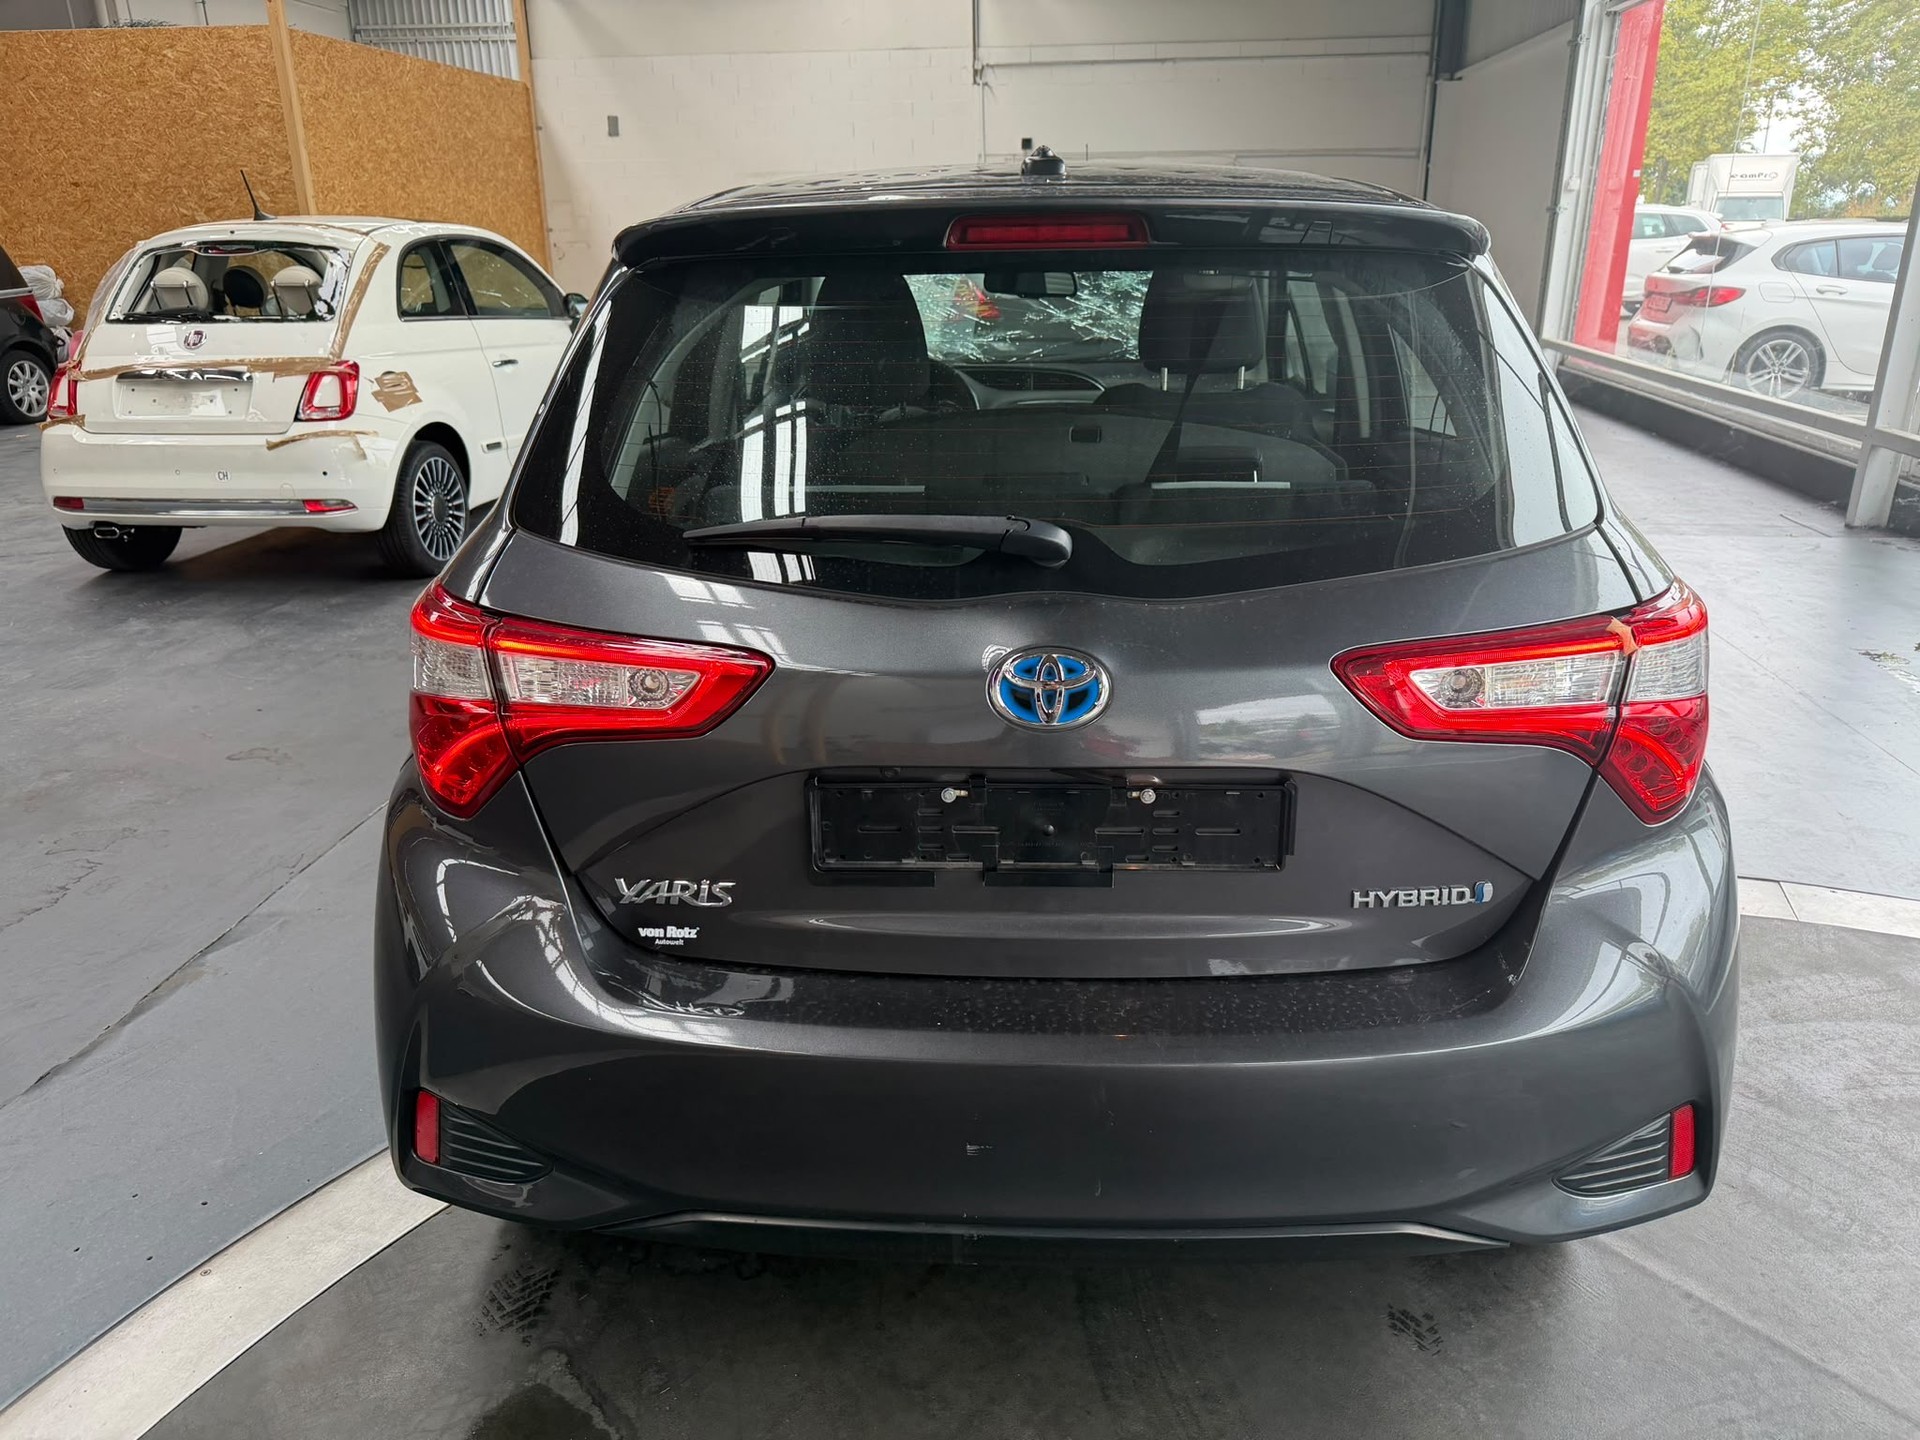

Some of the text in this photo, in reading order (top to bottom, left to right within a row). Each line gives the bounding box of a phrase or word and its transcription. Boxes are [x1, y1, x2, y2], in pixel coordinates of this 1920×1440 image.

[217, 471, 229, 481] CH
[1352, 885, 1472, 909] HYBRID
[637, 926, 699, 938] von Rotz
[655, 938, 684, 946] Autowelt
